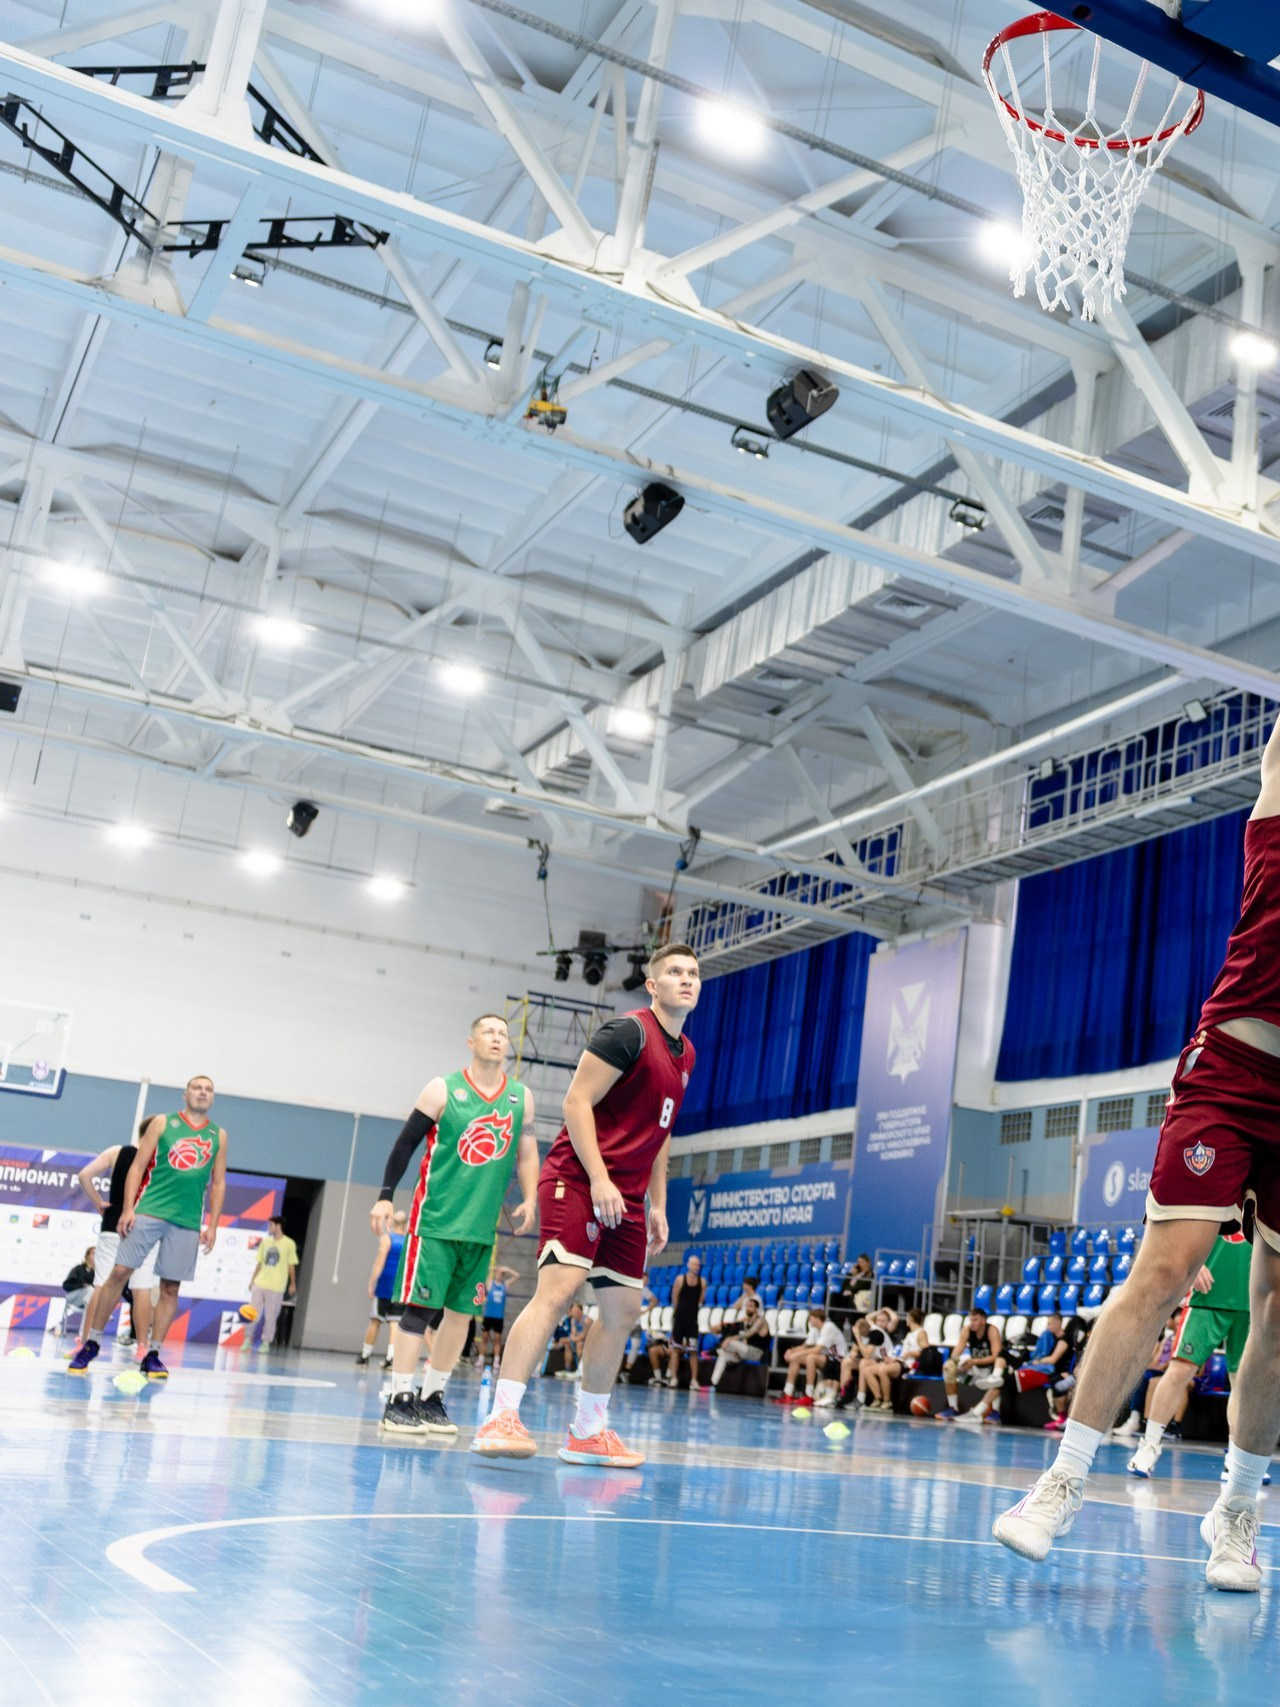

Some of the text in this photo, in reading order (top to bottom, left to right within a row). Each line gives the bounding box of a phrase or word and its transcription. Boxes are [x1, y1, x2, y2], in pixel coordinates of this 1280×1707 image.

[659, 1097, 675, 1129] 8
[710, 1181, 836, 1210] МИНИСТЕРСТВО СПОРТА
[708, 1204, 814, 1229] ПРИМОРСКОГО КРАЯ
